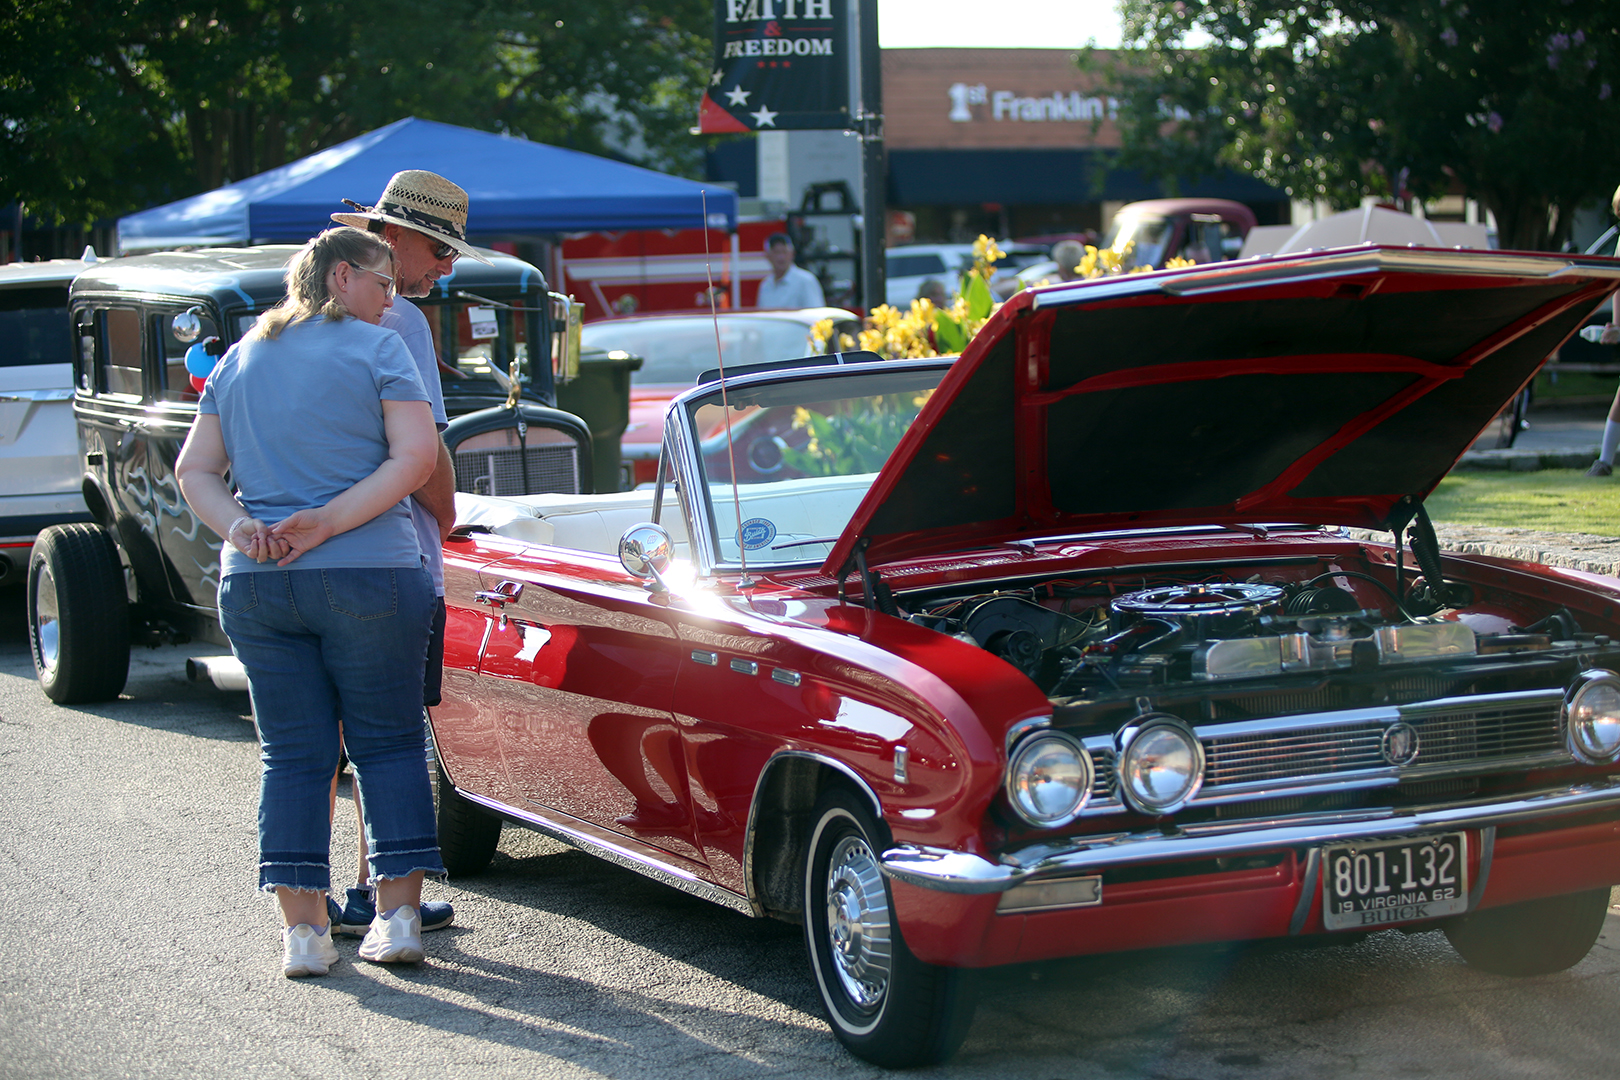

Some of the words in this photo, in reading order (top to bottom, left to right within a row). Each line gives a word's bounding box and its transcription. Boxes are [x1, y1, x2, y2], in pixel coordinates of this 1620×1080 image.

[725, 0, 834, 22] FAITH
[764, 20, 782, 36] &
[723, 38, 834, 58] FREEDOM
[948, 83, 988, 122] 1st
[993, 91, 1104, 121] Franklin
[1338, 901, 1354, 913] 19
[1360, 892, 1427, 910] VIRGINIA
[1432, 887, 1455, 901] 62
[1360, 904, 1429, 925] BUICK
